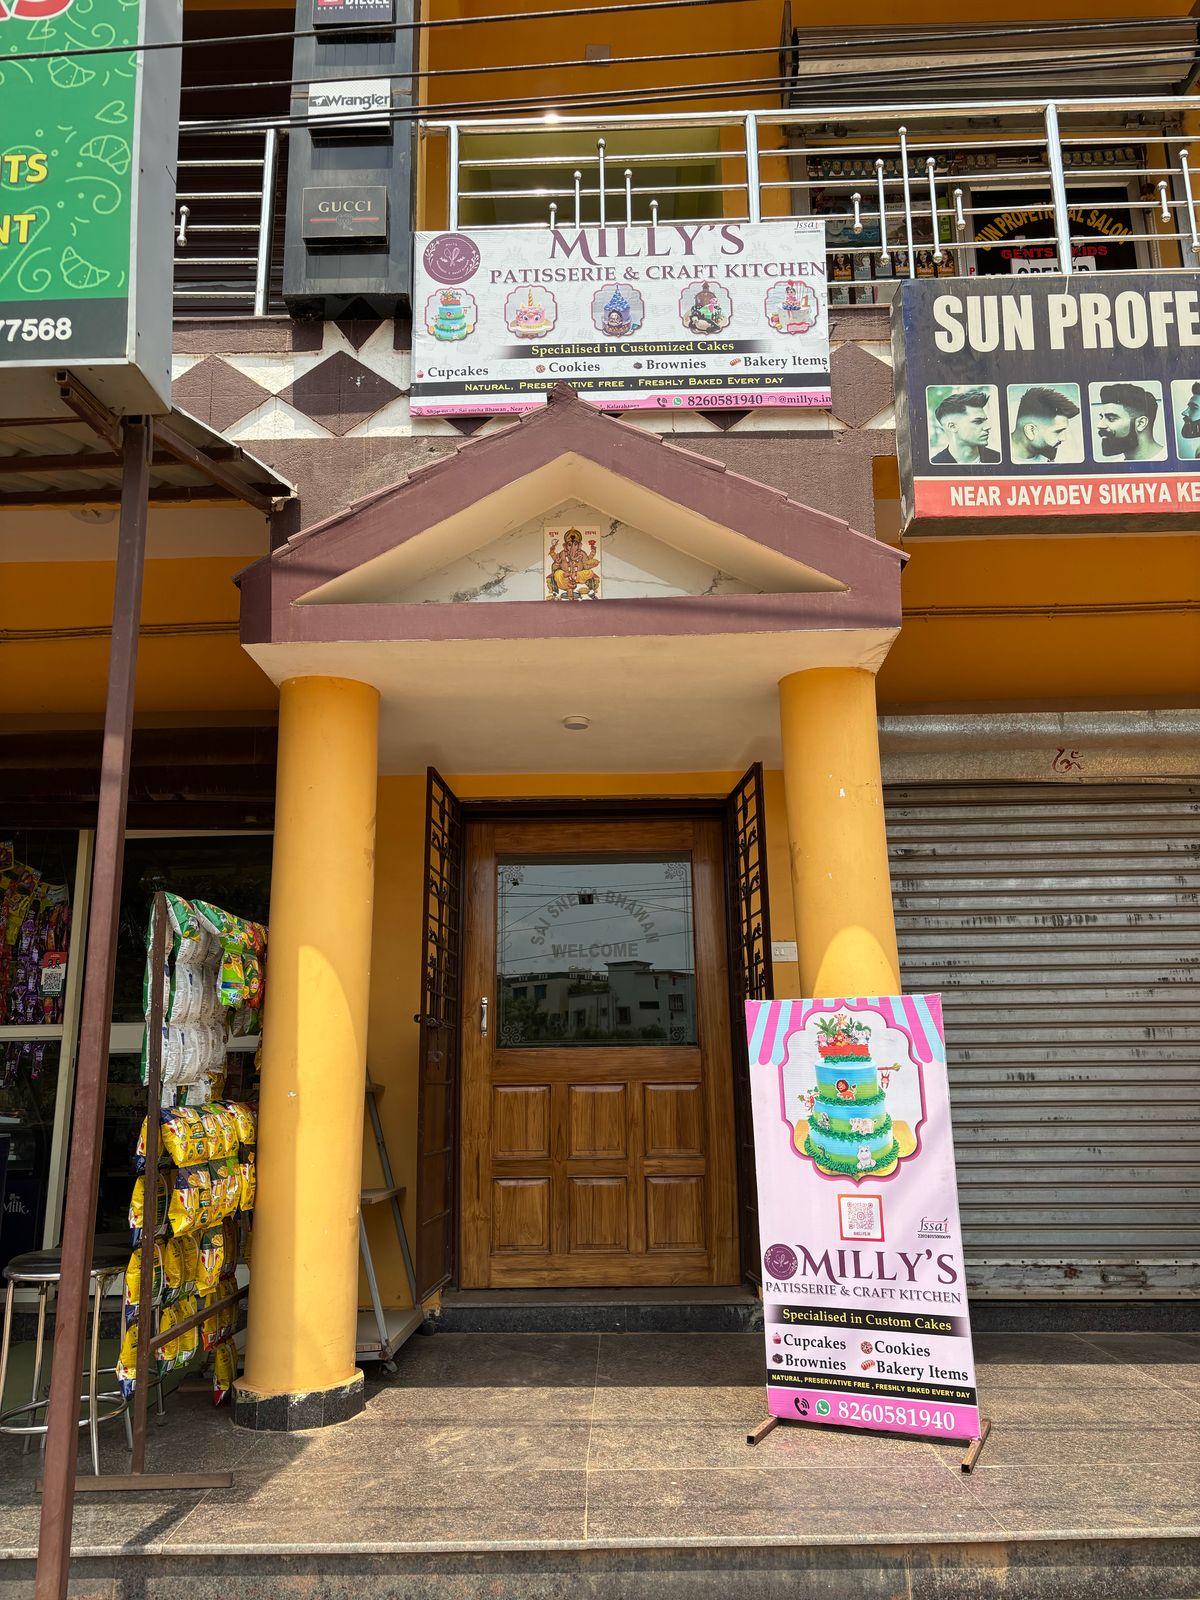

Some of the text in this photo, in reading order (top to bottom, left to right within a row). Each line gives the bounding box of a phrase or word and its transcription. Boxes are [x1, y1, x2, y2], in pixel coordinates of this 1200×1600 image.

[326, 94, 390, 110] Wrangler
[0, 153, 48, 184] TS
[318, 200, 372, 213] GUCCI
[548, 224, 745, 266] MILLY'S
[1001, 245, 1108, 260] GENTS KIDS
[489, 267, 617, 284] PATISSERIE
[623, 266, 640, 281] &
[645, 264, 718, 280] CRAFT
[724, 261, 825, 278] KITCHEN
[933, 290, 1200, 353] SUN PROFE
[531, 340, 735, 358] Specialised in Customized Cakes
[548, 361, 601, 373] Cookies
[646, 358, 707, 370] Brownies
[743, 355, 828, 368] Bakery Items
[427, 365, 489, 379] Cupcakes
[519, 380, 594, 390] PRESEATIVE
[598, 379, 625, 388] FREE
[638, 378, 685, 387] FRESHLY
[688, 377, 723, 386] BAKED
[727, 376, 760, 385] EVERY
[765, 376, 784, 385] DAY
[687, 394, 763, 406] 8260581940
[950, 481, 1200, 506] NEAR JAYADEV SIKHYA KE
[530, 917, 551, 945] SAI
[552, 943, 638, 958] WELCOME
[918, 1217, 948, 1233] fssai
[795, 1244, 958, 1285] MILLY'S
[765, 1281, 962, 1304] PATISSERIE & CRAFT KITCHEN
[782, 1308, 952, 1331] Specialised in Custom Cakes
[783, 1333, 847, 1351] Cupcakes
[874, 1340, 931, 1357] Cookies
[785, 1353, 847, 1370] Brownies
[876, 1359, 969, 1381] Bakery Items
[804, 1376, 852, 1387] PRESERVATIVE
[853, 1380, 870, 1389] FREE
[875, 1383, 905, 1393] FRESHLY
[907, 1386, 930, 1395] BAKED
[932, 1388, 954, 1397] EVERY
[956, 1391, 971, 1399] DAY
[838, 1400, 955, 1431] 8260581940
